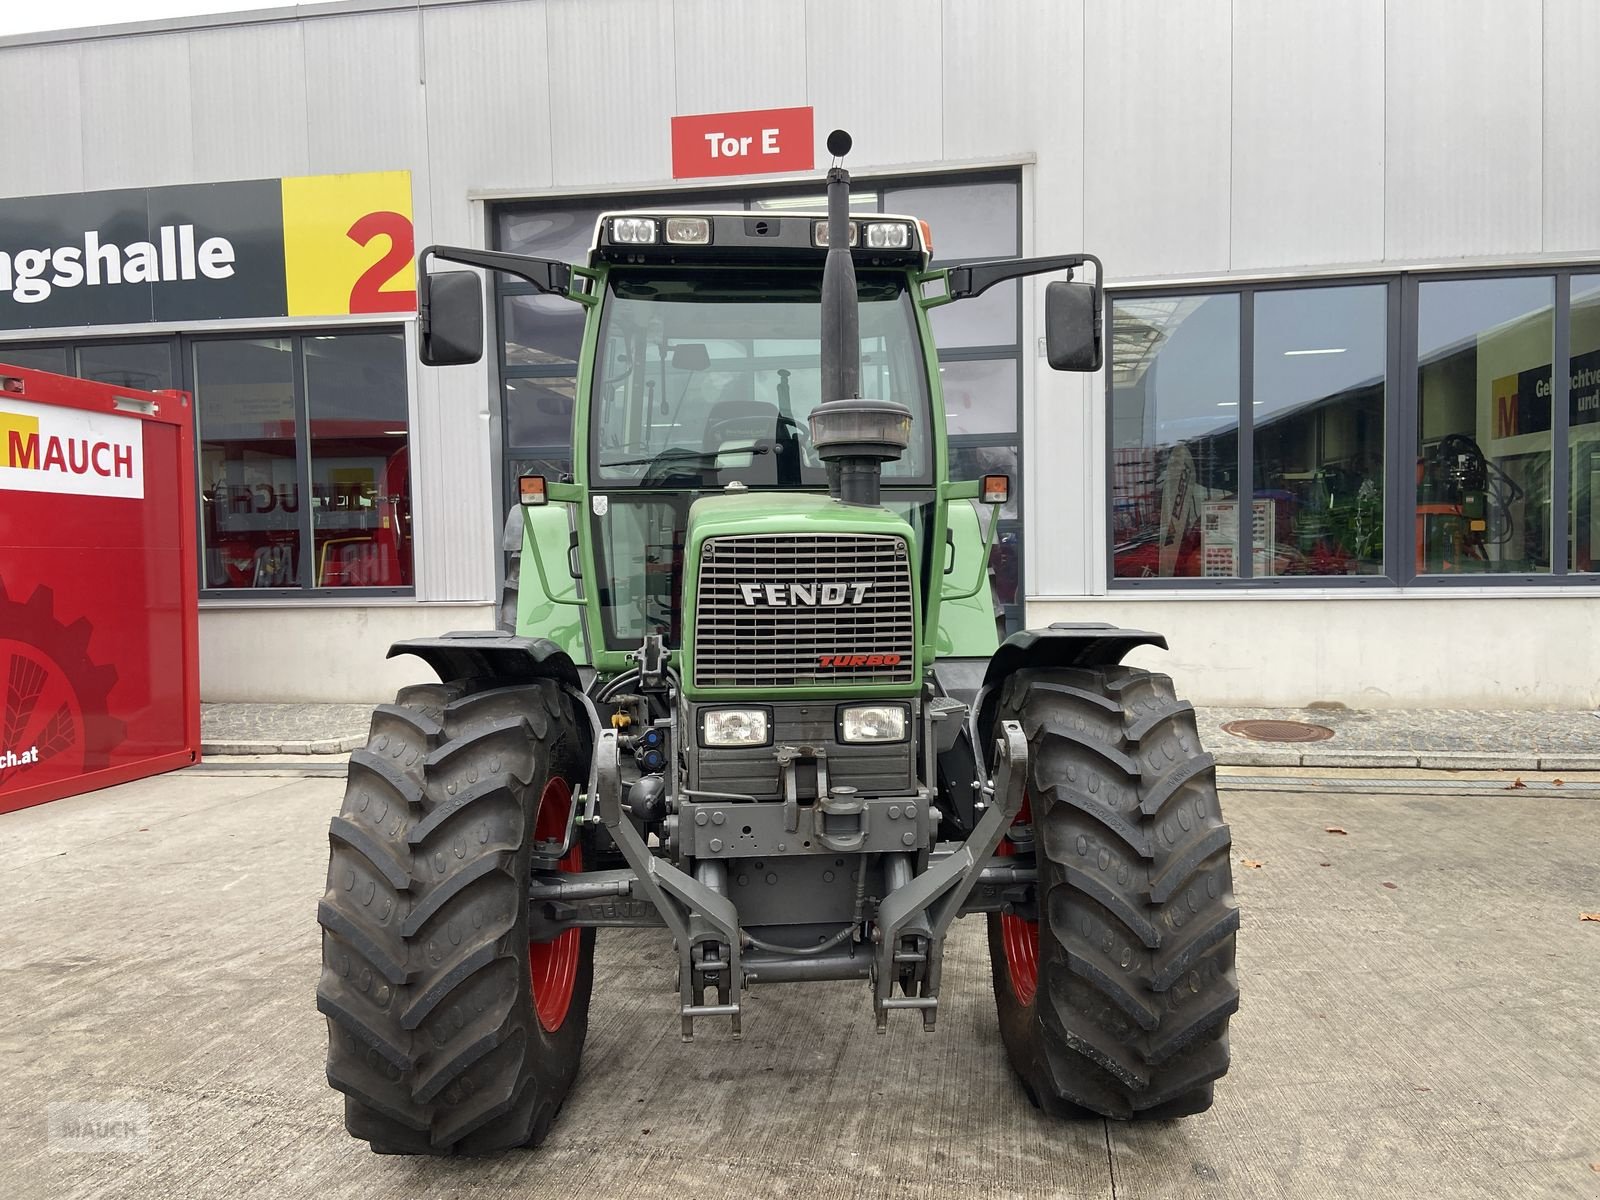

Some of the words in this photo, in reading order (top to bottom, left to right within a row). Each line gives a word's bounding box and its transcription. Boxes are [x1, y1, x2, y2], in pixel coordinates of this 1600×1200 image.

[704, 132, 753, 158] Tor
[761, 128, 780, 155] E
[346, 211, 417, 314] 2
[8, 430, 133, 479] MAUCH
[739, 582, 874, 606] FENDT
[818, 654, 901, 667] TURBO
